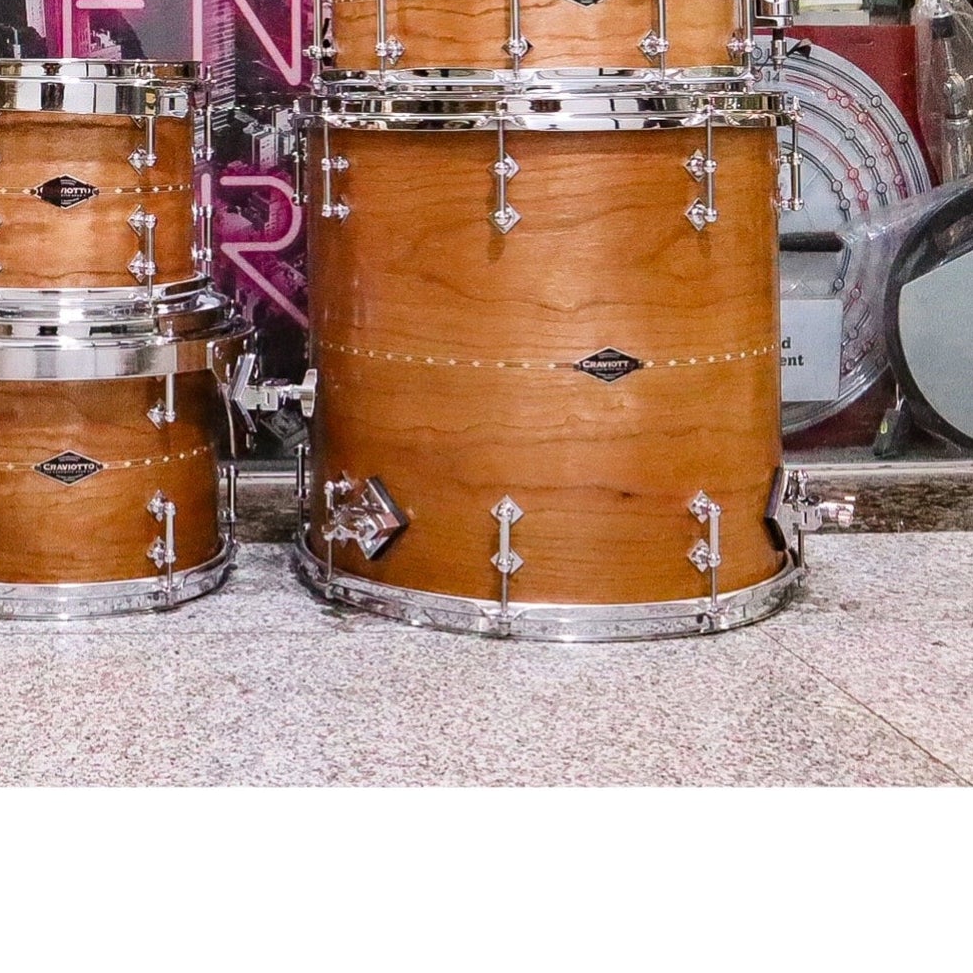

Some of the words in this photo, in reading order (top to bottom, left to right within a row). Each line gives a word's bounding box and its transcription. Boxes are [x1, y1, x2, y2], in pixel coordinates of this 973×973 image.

[767, 70, 781, 83] 14
[582, 360, 635, 368] CRAVIOTT
[43, 463, 95, 471] CRAVIOTTO
